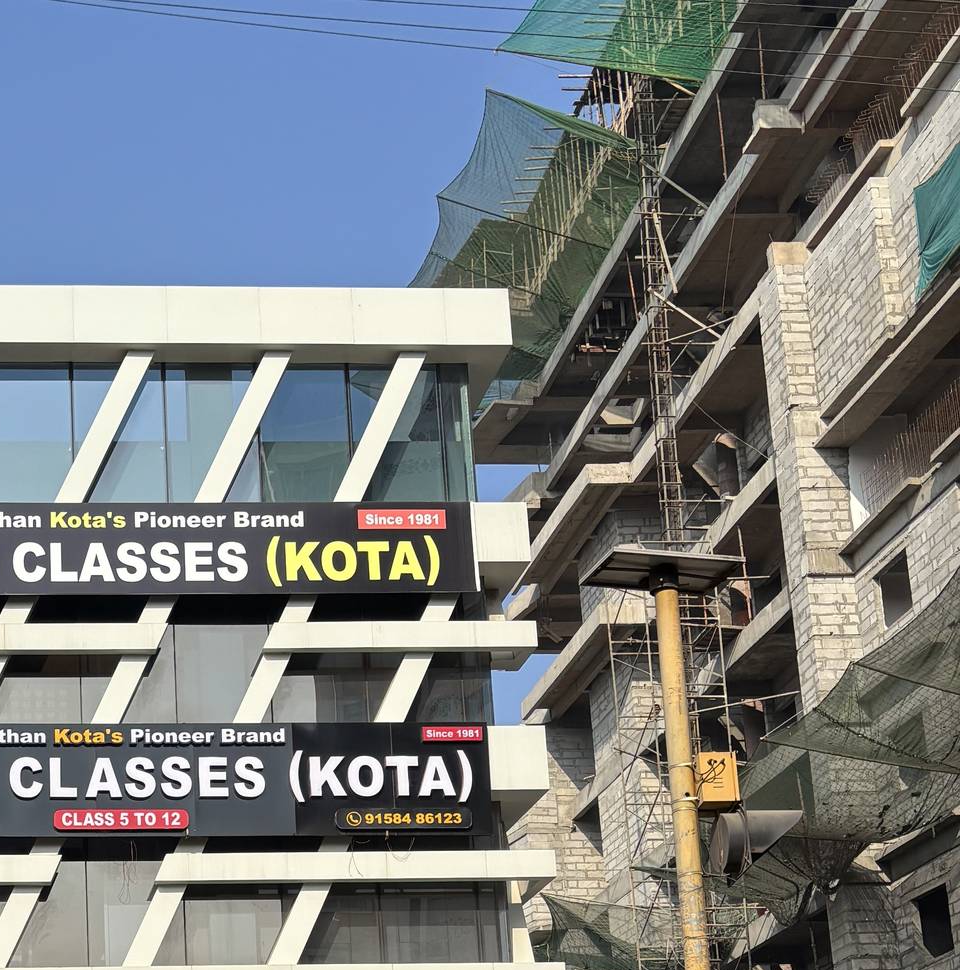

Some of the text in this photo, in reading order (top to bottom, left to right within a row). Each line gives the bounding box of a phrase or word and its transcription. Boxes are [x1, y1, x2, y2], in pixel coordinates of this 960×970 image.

[50, 511, 126, 529] Kota's
[134, 511, 227, 528] Pioneer
[233, 510, 305, 528] Brand
[365, 513, 440, 525] Since 1981
[12, 541, 249, 583] CLASSES
[266, 535, 441, 587] (KOTA)
[53, 728, 123, 744] Kota's
[130, 728, 214, 744] Pioneer
[221, 727, 286, 743] Brand
[426, 729, 480, 738] Since 1981
[9, 756, 266, 798] CLASSES
[289, 750, 473, 802] (KOTA)
[62, 813, 181, 826] CLASS 5 TO 12
[365, 813, 462, 825] 91584 86123
